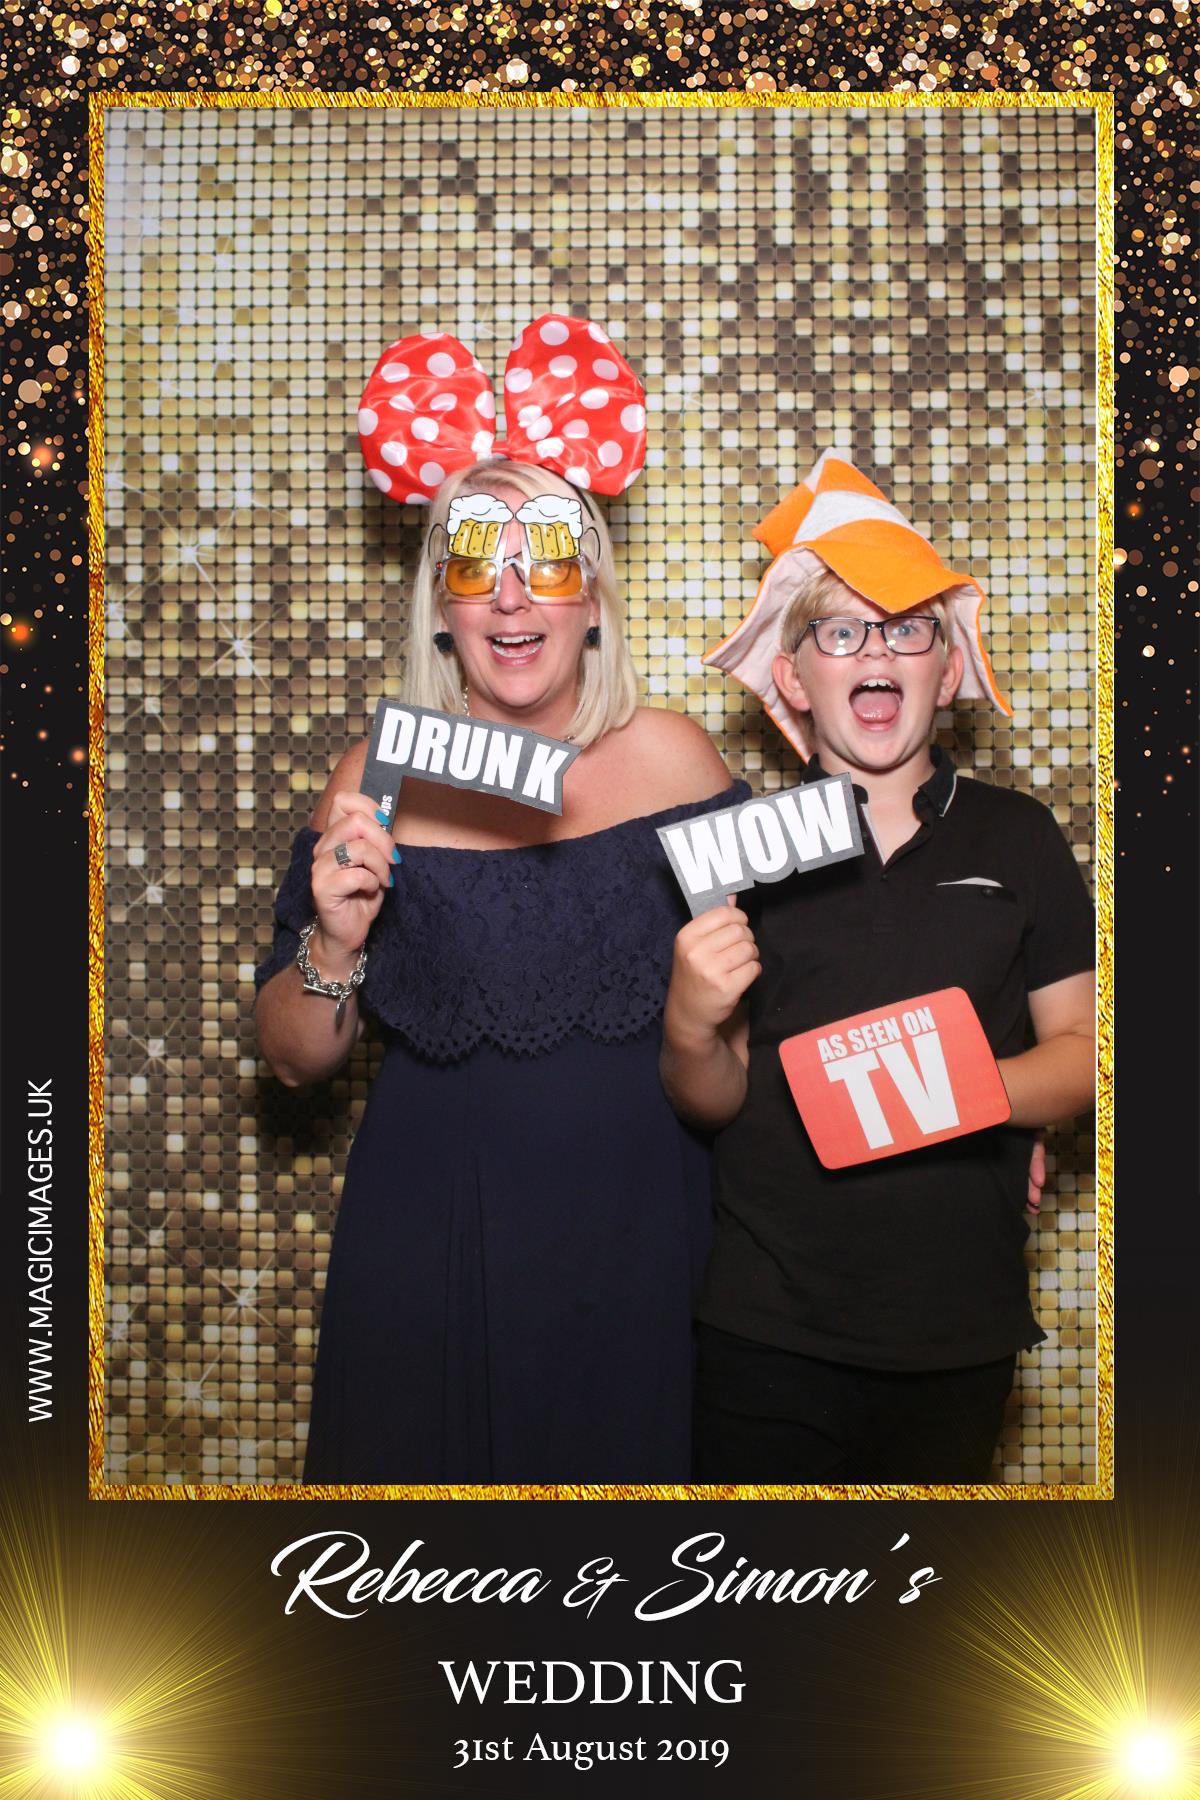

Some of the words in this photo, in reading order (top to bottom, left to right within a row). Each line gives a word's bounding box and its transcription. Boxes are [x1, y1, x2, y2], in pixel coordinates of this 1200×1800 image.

[376, 707, 569, 804] DRUNK
[665, 780, 854, 895] WOW
[817, 1033, 848, 1062] AS
[847, 1017, 902, 1053] SEEN
[902, 1006, 936, 1036] ON
[823, 1030, 960, 1150] TV
